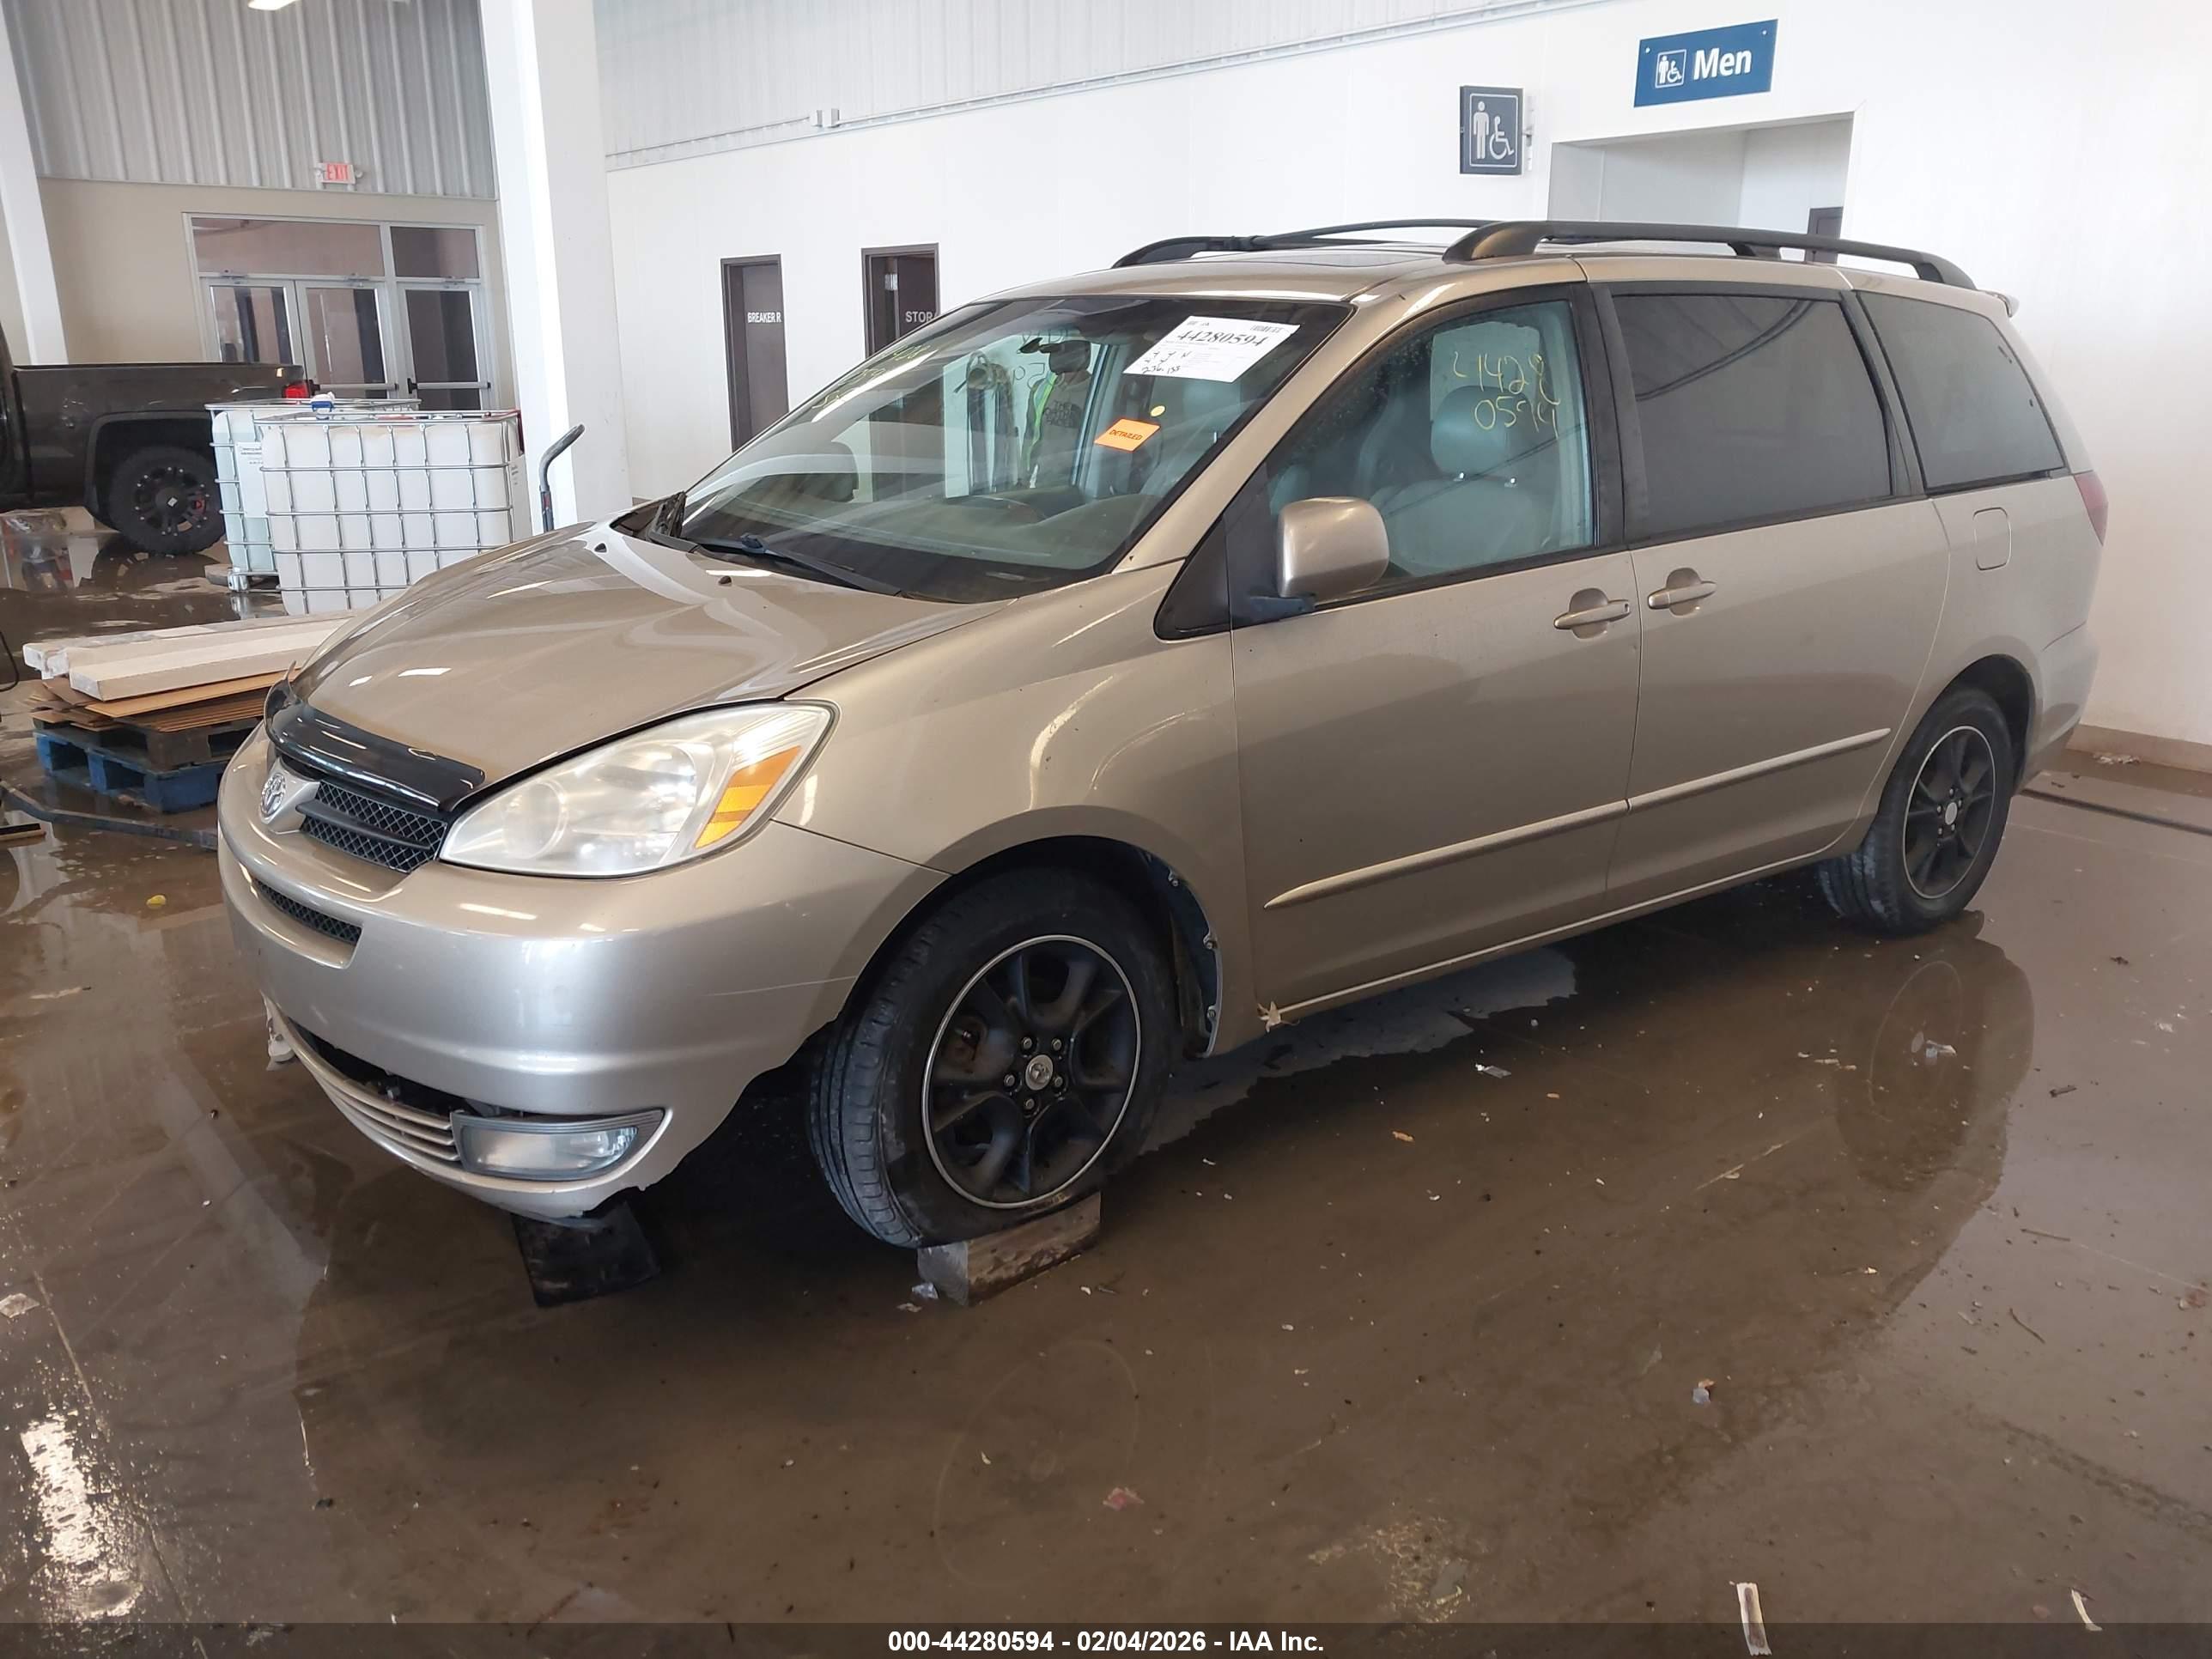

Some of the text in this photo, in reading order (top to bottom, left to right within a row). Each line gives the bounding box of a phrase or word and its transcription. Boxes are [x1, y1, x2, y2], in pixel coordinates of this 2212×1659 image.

[1693, 47, 1752, 81] Men
[747, 311, 775, 324] BREAKER
[1177, 330, 1269, 346] 44280594
[1109, 428, 1144, 441] DETAILED
